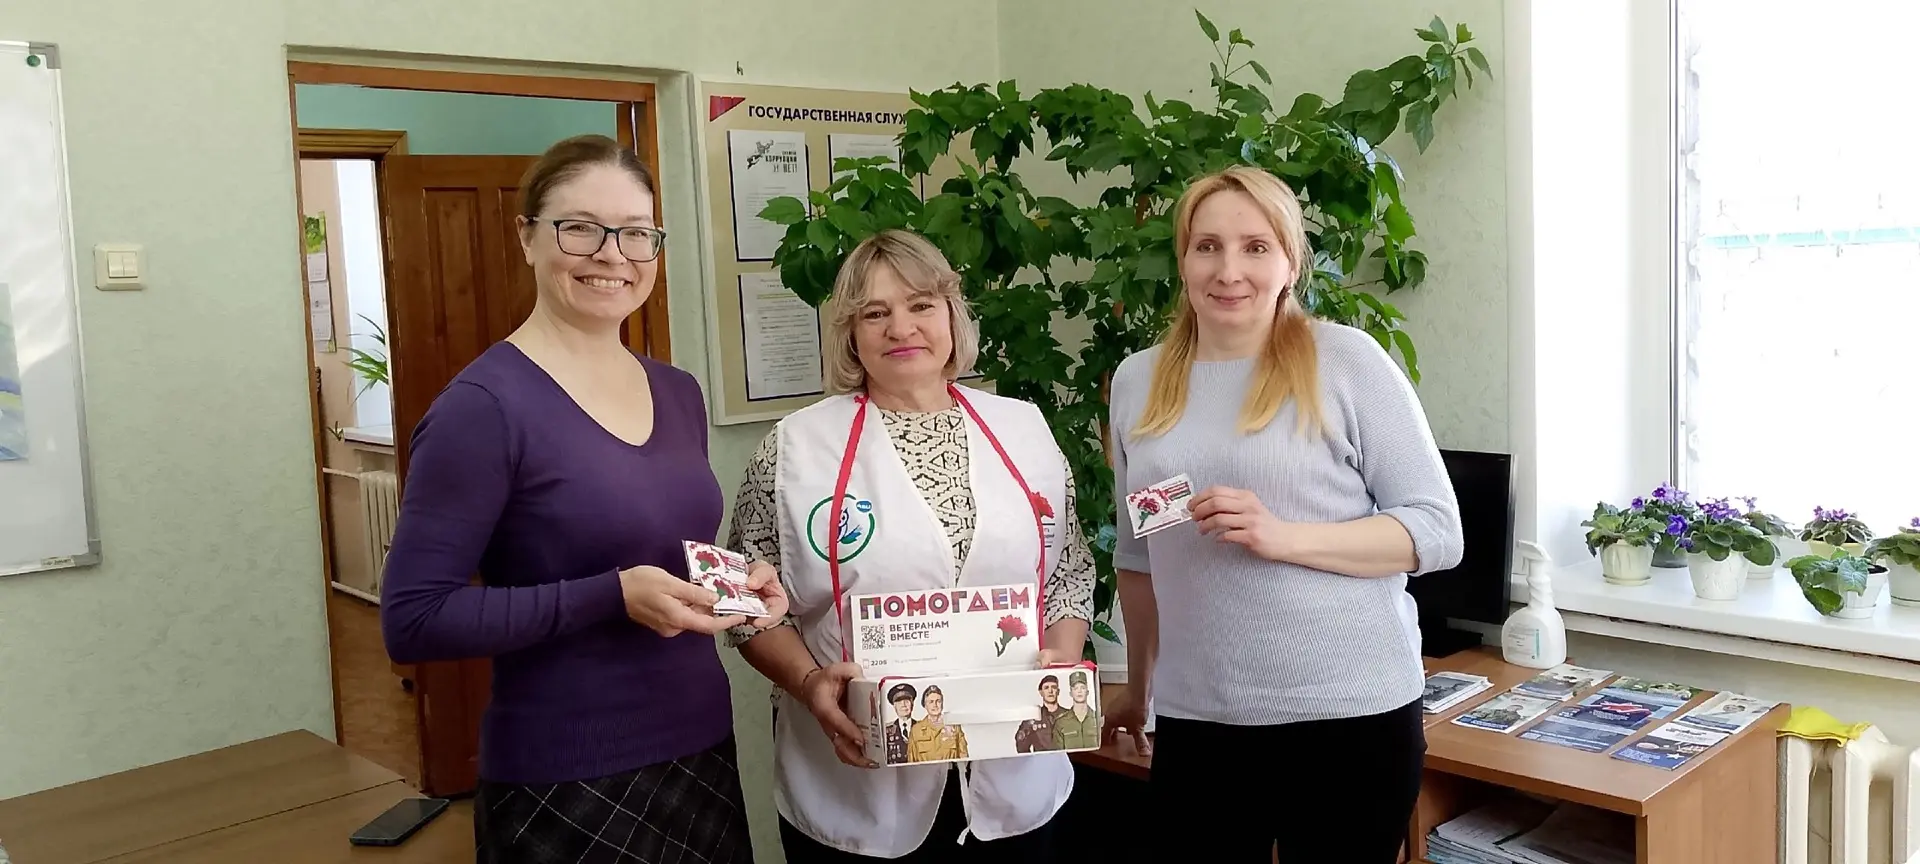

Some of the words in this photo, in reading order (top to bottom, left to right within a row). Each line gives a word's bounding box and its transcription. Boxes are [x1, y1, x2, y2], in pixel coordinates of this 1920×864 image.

[748, 105, 873, 124] ГОСУДАРСТВЕННАЯ
[859, 587, 1030, 620] ПОМОГАЕМ
[889, 620, 950, 632] ВЕТЕРАНАМ
[890, 631, 930, 641] ВМЕСТЕ
